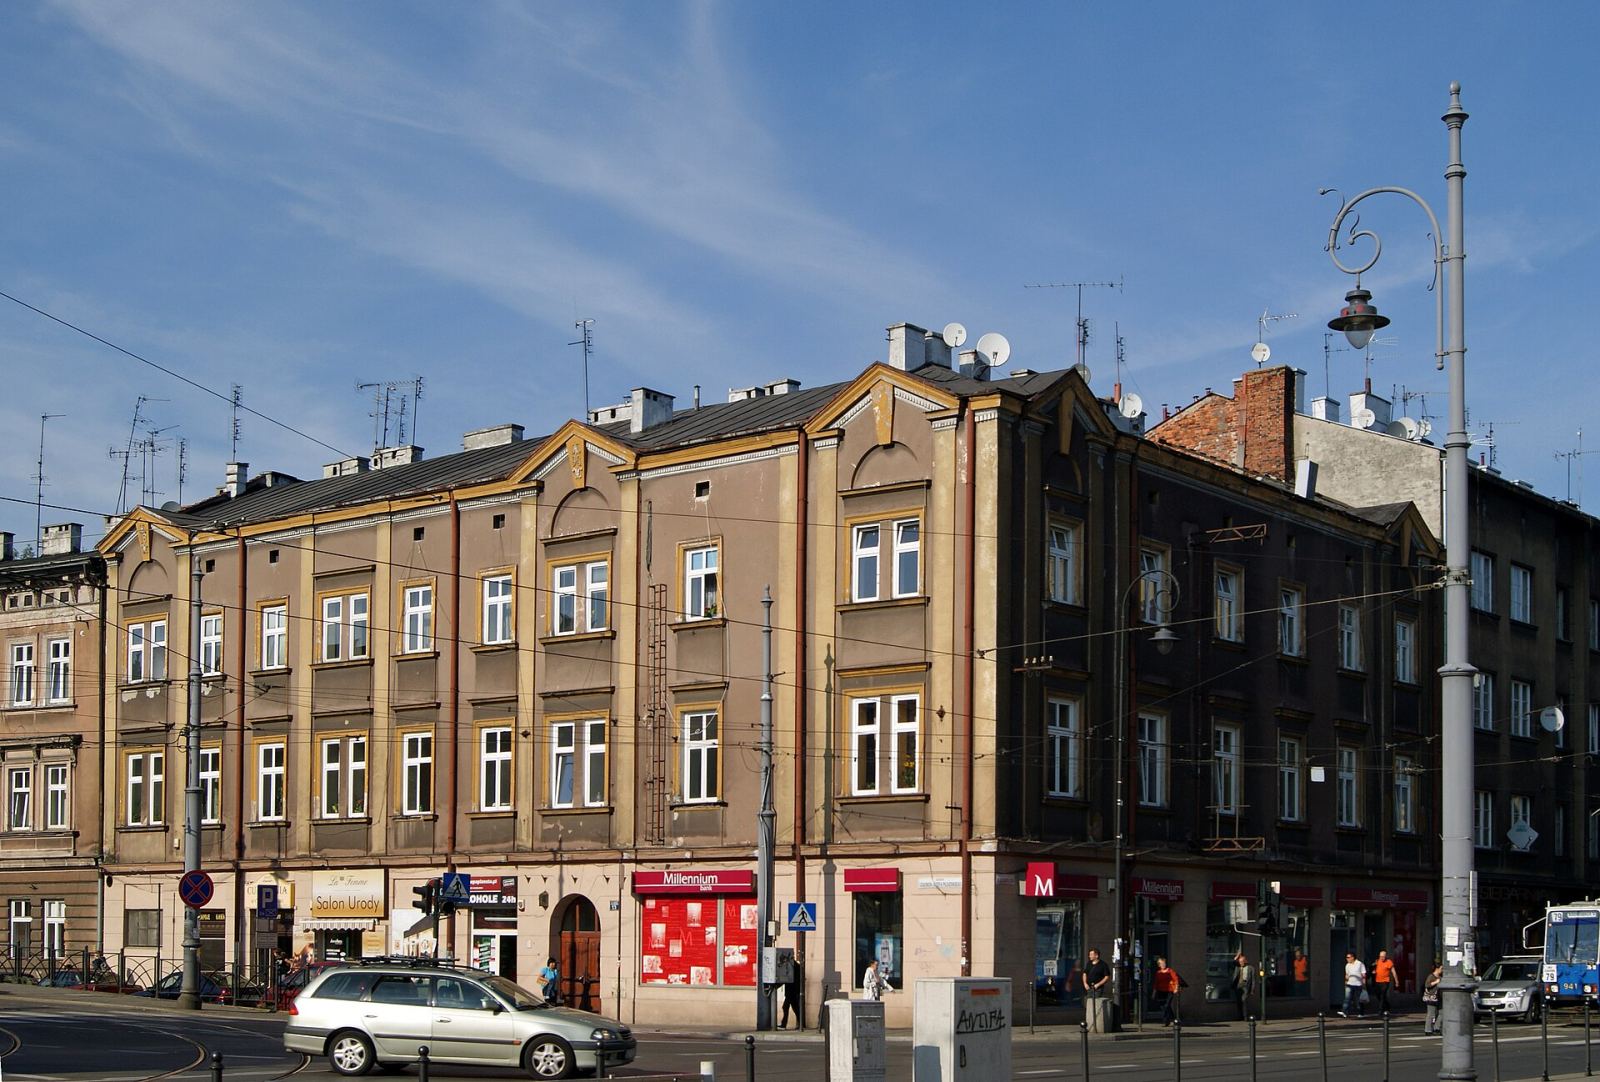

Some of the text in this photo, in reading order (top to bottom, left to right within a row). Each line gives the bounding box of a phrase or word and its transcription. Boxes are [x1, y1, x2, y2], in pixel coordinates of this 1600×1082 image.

[663, 871, 718, 885] Millennium
[1034, 874, 1054, 896] M
[316, 895, 380, 913] Salon Urody
[469, 894, 517, 904] OHOLE 24h
[1553, 912, 1563, 922] 79
[1545, 973, 1555, 981] 79
